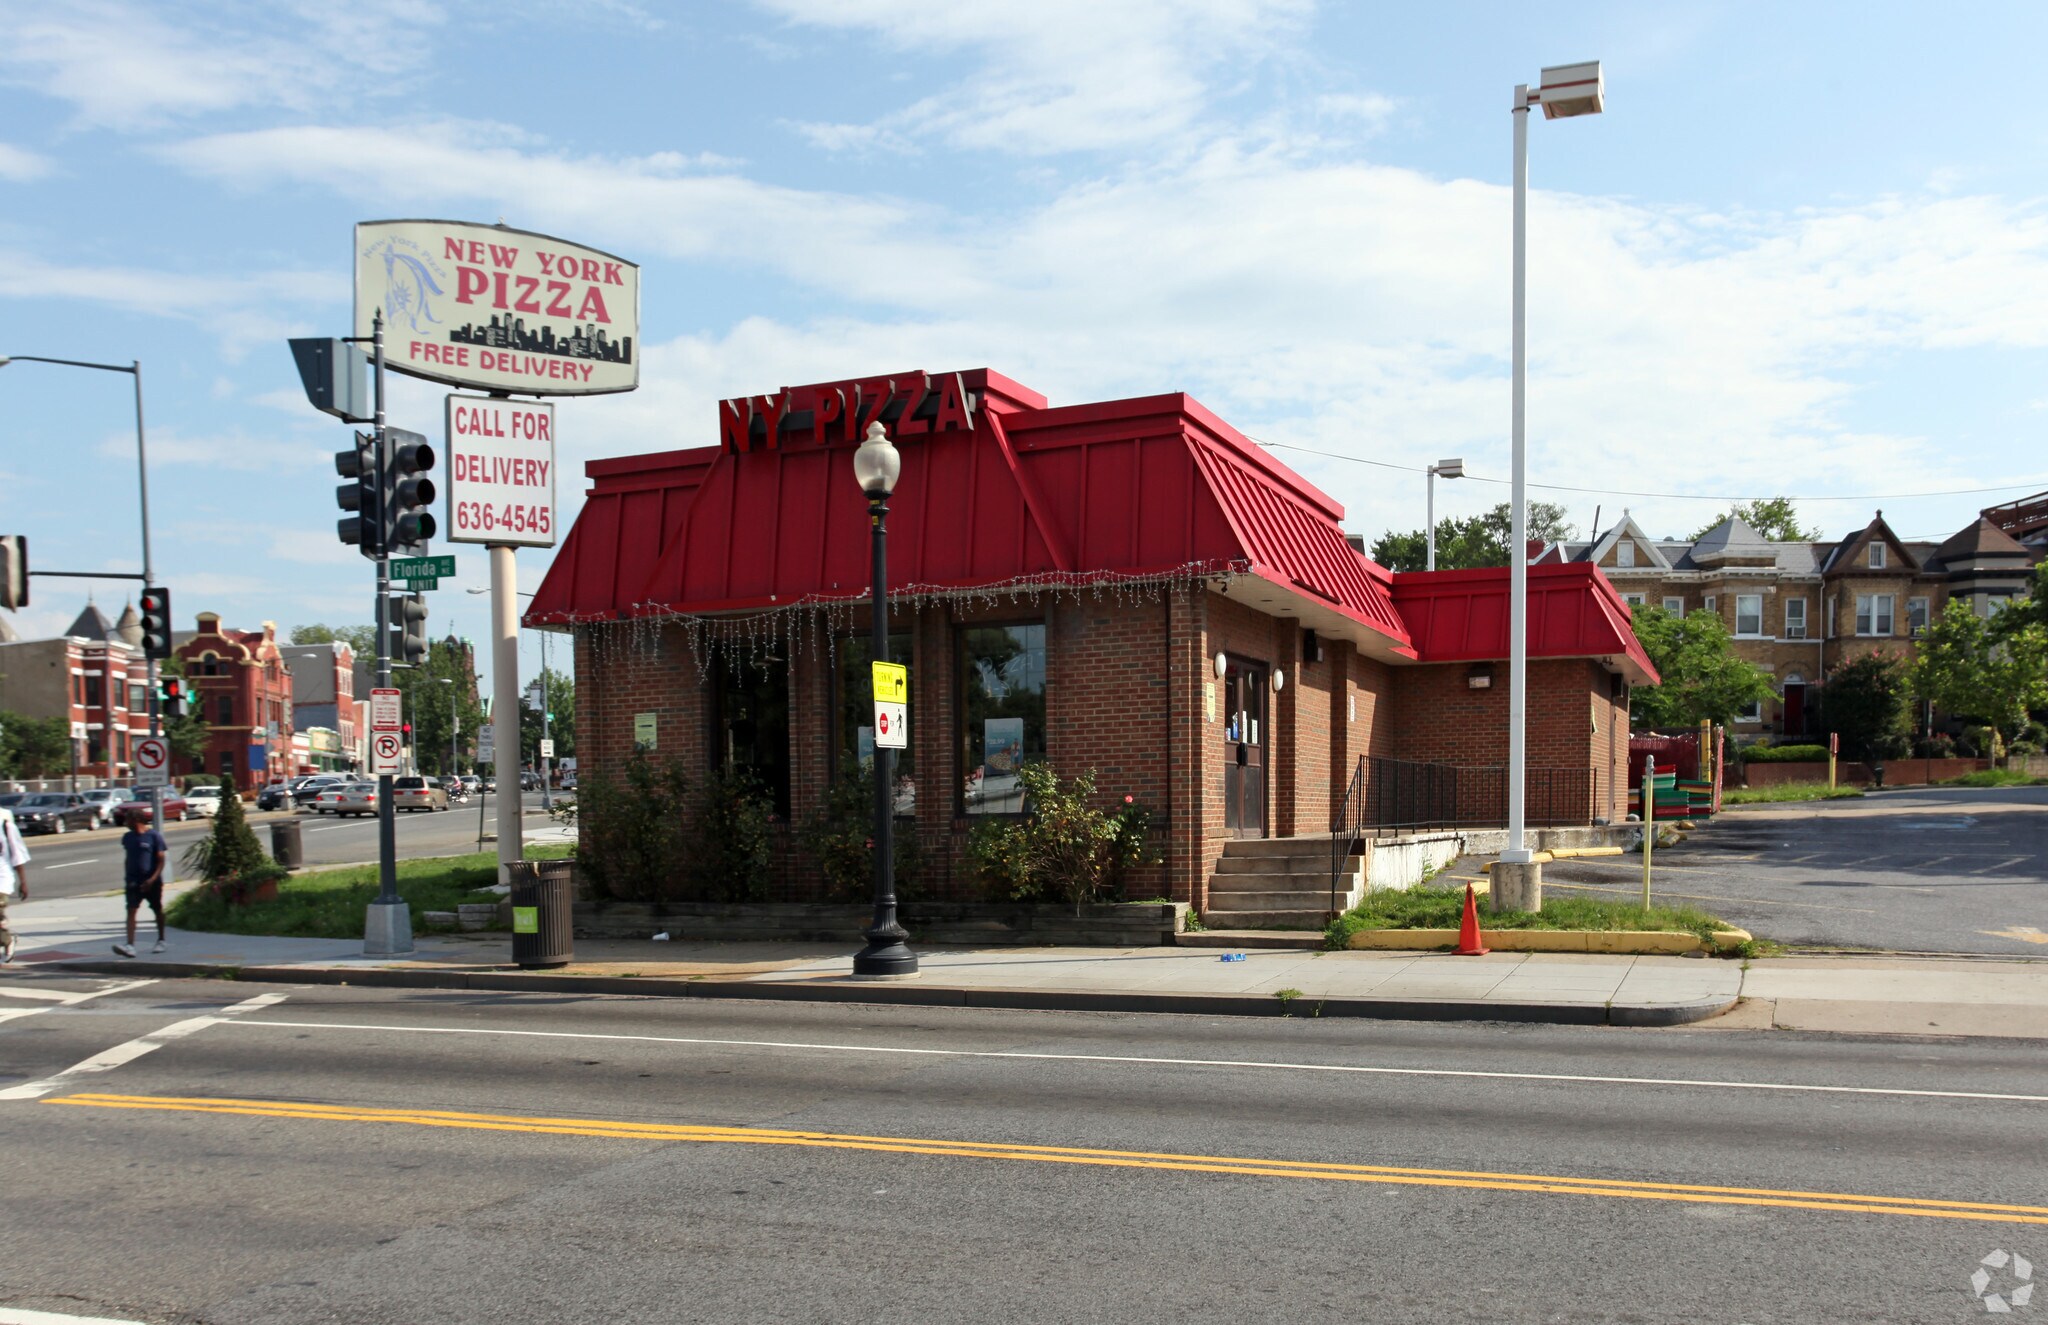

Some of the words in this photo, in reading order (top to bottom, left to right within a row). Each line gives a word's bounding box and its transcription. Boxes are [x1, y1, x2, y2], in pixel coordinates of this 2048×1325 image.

[362, 239, 386, 259] New
[390, 235, 419, 251] York
[421, 250, 446, 279] Pizza
[443, 236, 519, 269] NEW
[535, 251, 624, 286] YORK
[455, 265, 612, 324] PIZZA
[409, 340, 470, 367] FREE
[479, 350, 594, 383] DELIVERY
[455, 405, 505, 438] CALL
[511, 411, 550, 441] FOR
[718, 391, 791, 455] NY
[812, 371, 975, 445] PIZZA
[455, 453, 550, 487] DELIVERY
[457, 500, 550, 534] 636-4545
[394, 561, 436, 577] Florida
[410, 579, 435, 590] UNIT
